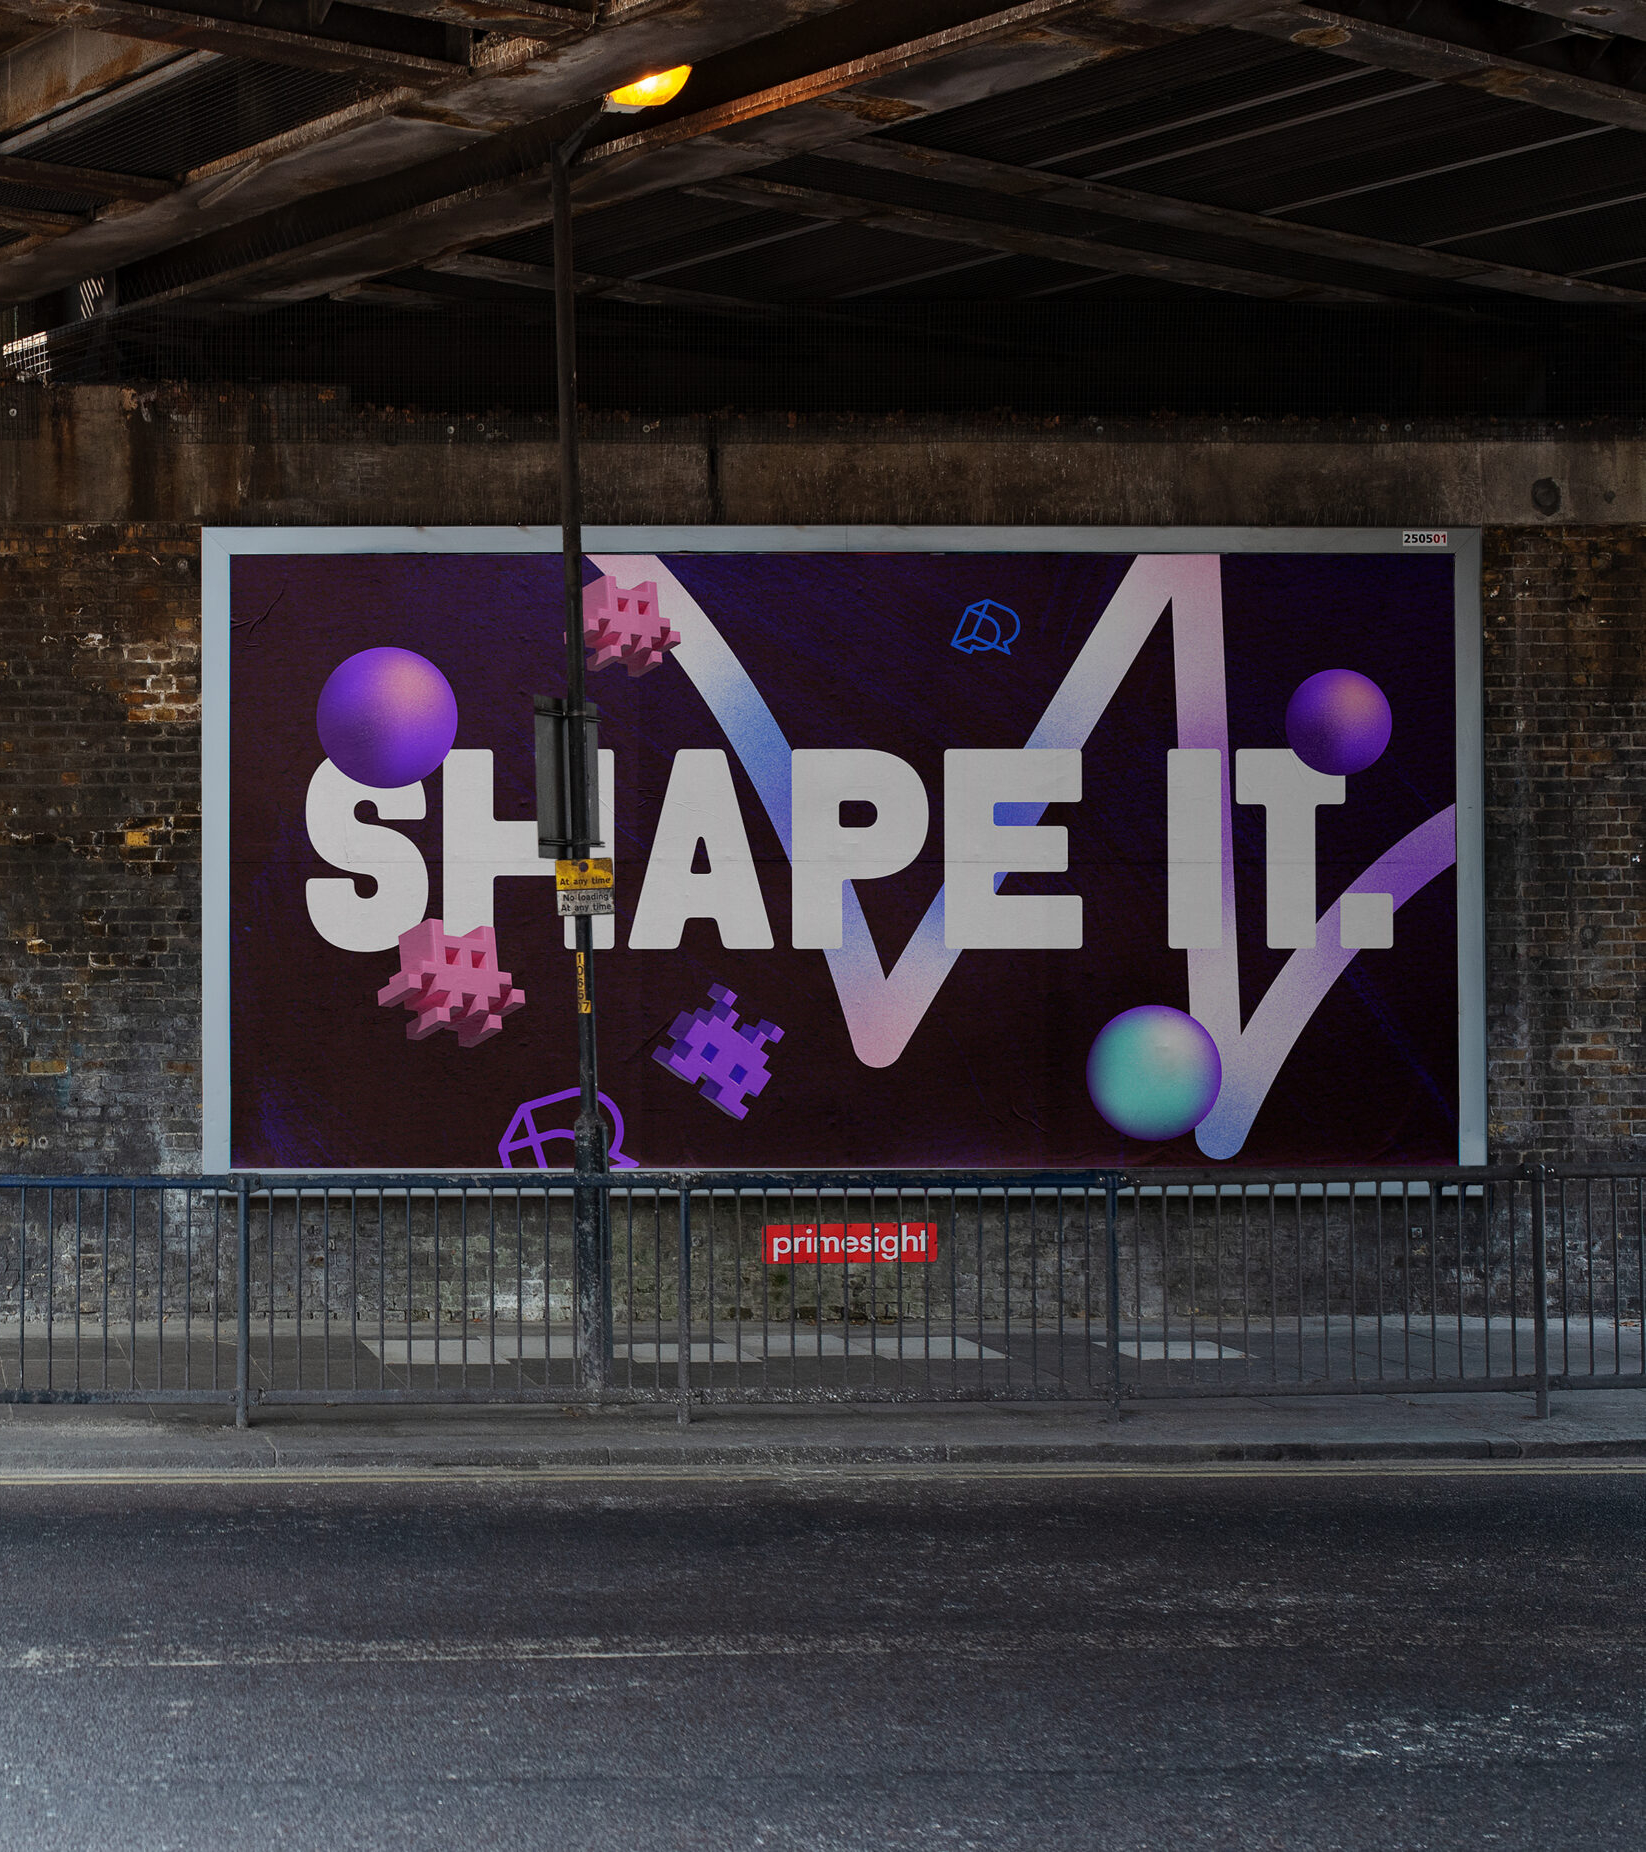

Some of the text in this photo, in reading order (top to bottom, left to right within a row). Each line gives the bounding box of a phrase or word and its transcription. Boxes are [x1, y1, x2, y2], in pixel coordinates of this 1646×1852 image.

[1404, 533, 1447, 544] 250501
[305, 748, 1395, 953] SHAPE IT.
[560, 876, 611, 887] At any time
[578, 892, 609, 901] loading
[561, 903, 612, 913] At any time
[772, 1224, 930, 1262] primesight
